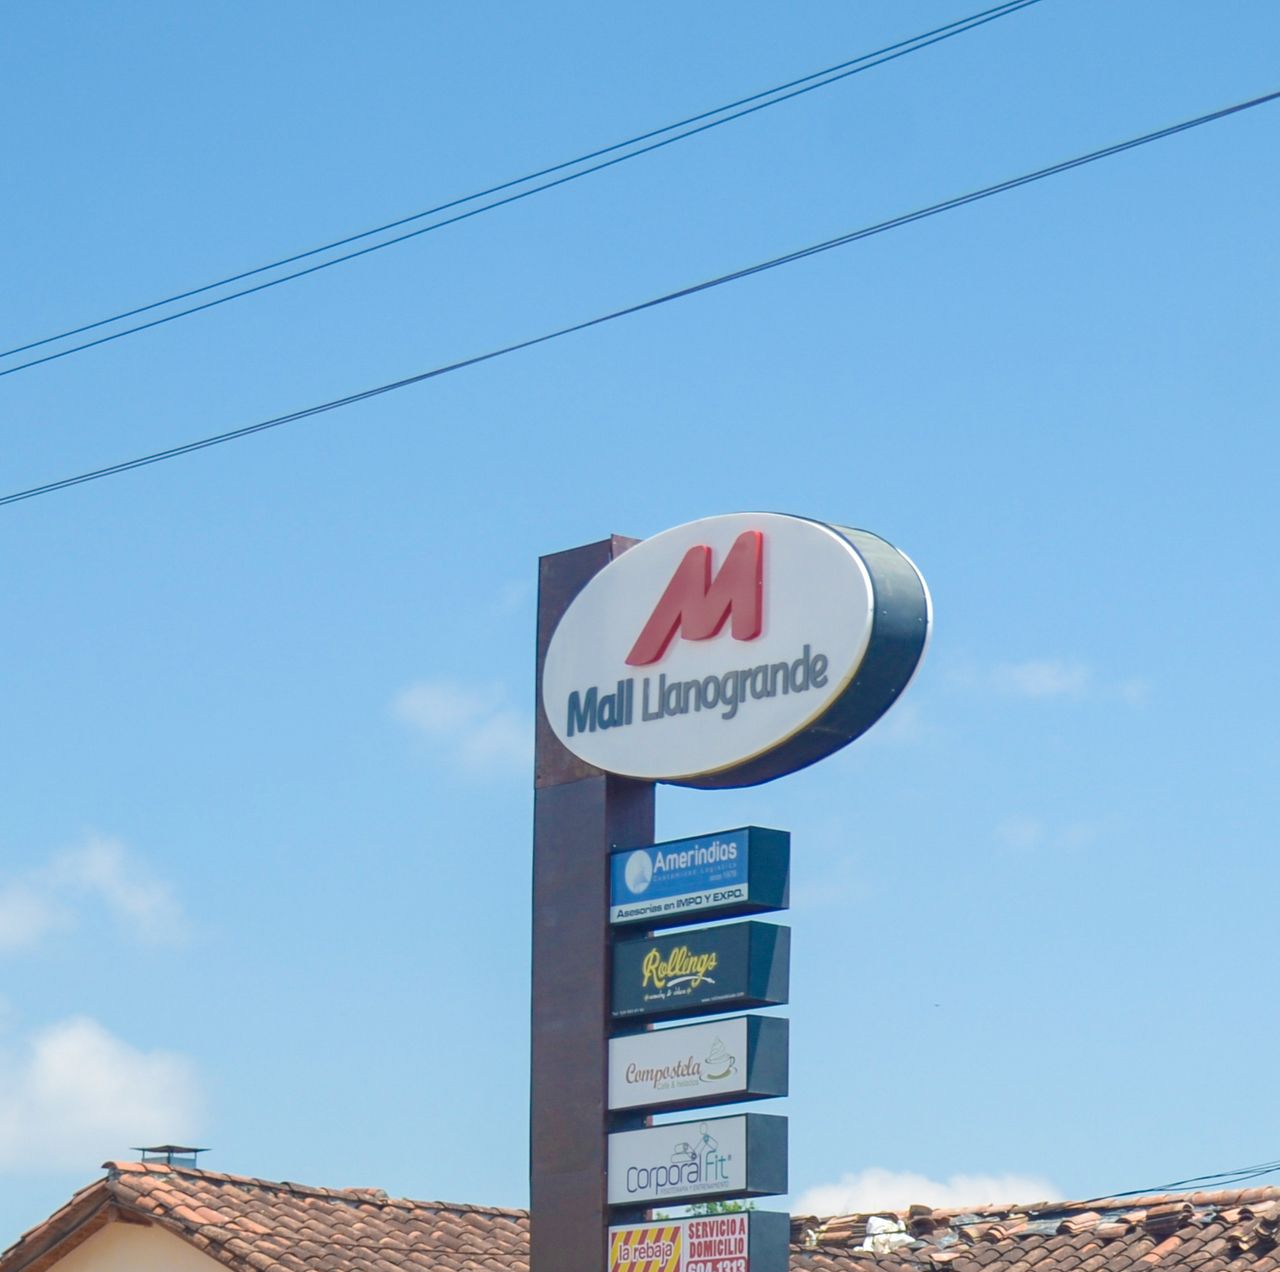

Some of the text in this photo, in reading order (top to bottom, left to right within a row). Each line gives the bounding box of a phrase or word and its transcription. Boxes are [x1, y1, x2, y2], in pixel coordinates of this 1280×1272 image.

[567, 644, 828, 737] Mall Llanogrande
[653, 841, 737, 873] Amerindios
[664, 901, 675, 910] en
[676, 895, 702, 908] IMPO
[704, 893, 712, 903] Y
[641, 945, 718, 988] Rollings
[625, 1056, 701, 1088] Compostela
[627, 1153, 702, 1195] Corporal
[688, 1217, 746, 1240] SERVICIO A
[618, 1241, 673, 1266] la rebaja
[689, 1237, 744, 1259] DOMICILIO
